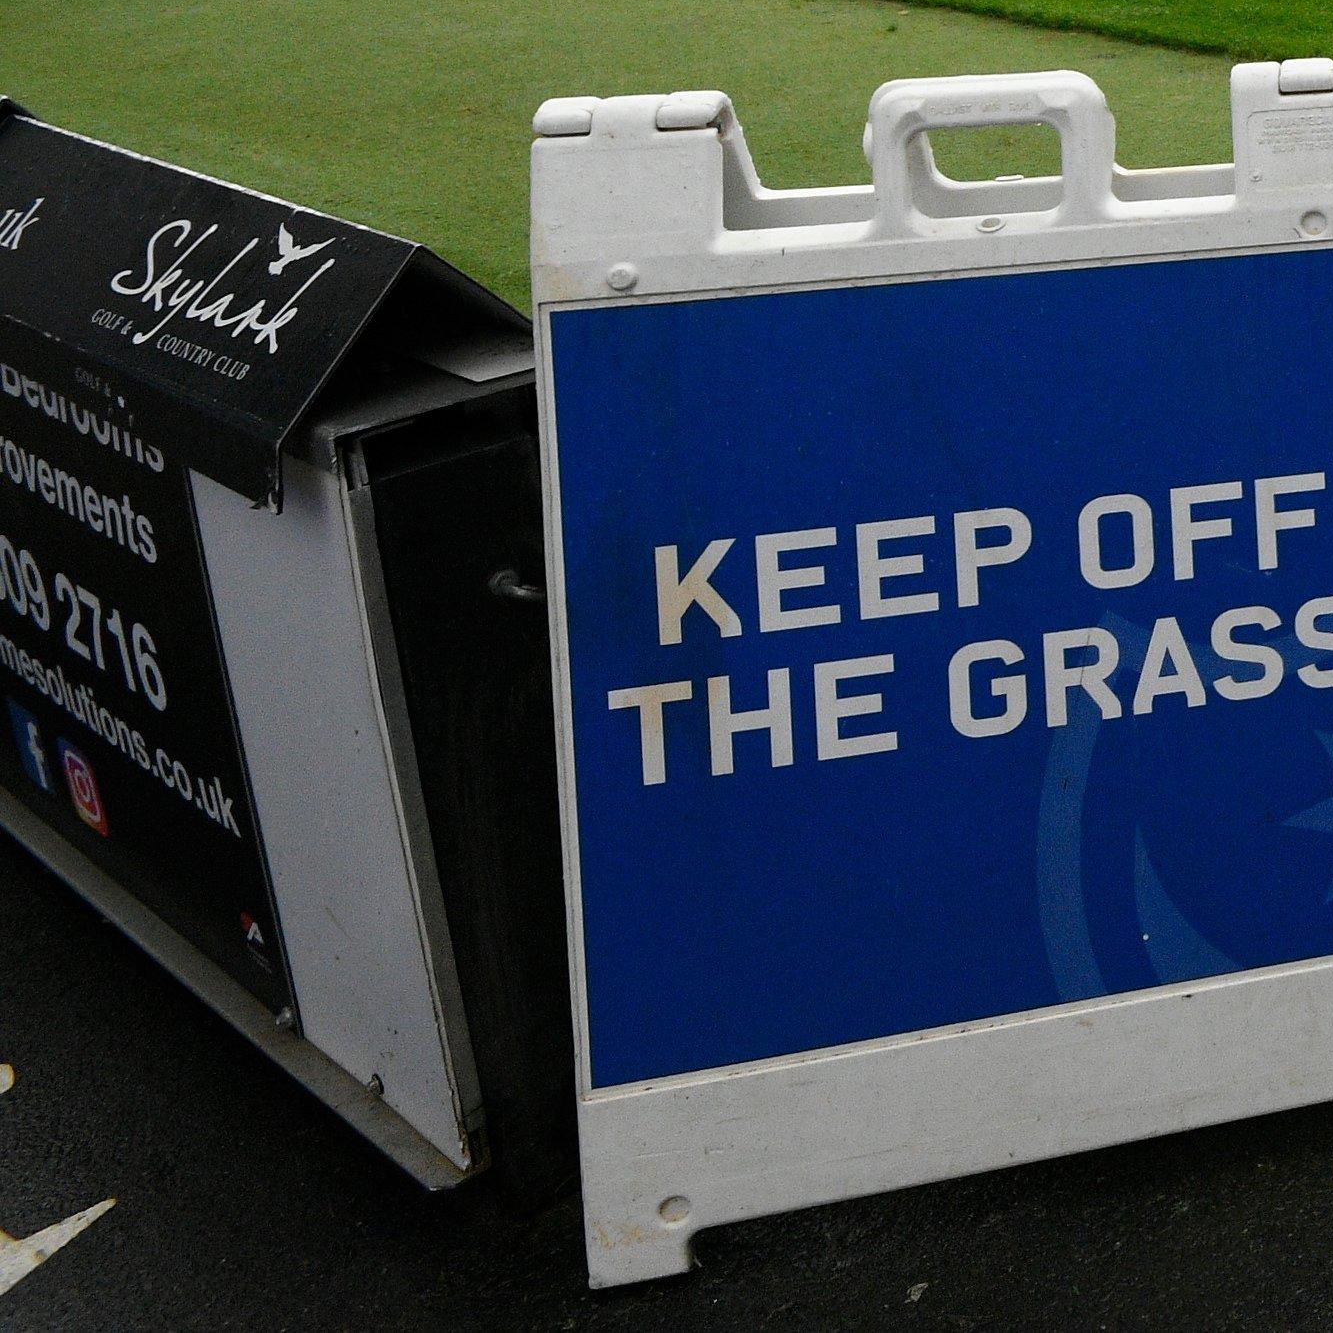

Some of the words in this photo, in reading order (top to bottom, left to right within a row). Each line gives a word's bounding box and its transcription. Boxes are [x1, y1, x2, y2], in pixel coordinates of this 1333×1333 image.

[91, 308, 120, 331] GOLF
[120, 320, 132, 335] &
[111, 219, 336, 355] Skylark
[156, 334, 216, 368] COUNTRY
[213, 355, 251, 381] CLUB
[0, 534, 50, 632] 09
[55, 572, 167, 712] 2716
[655, 507, 1032, 646] KEEP
[1078, 472, 1327, 589] OFF
[607, 653, 898, 787] THE
